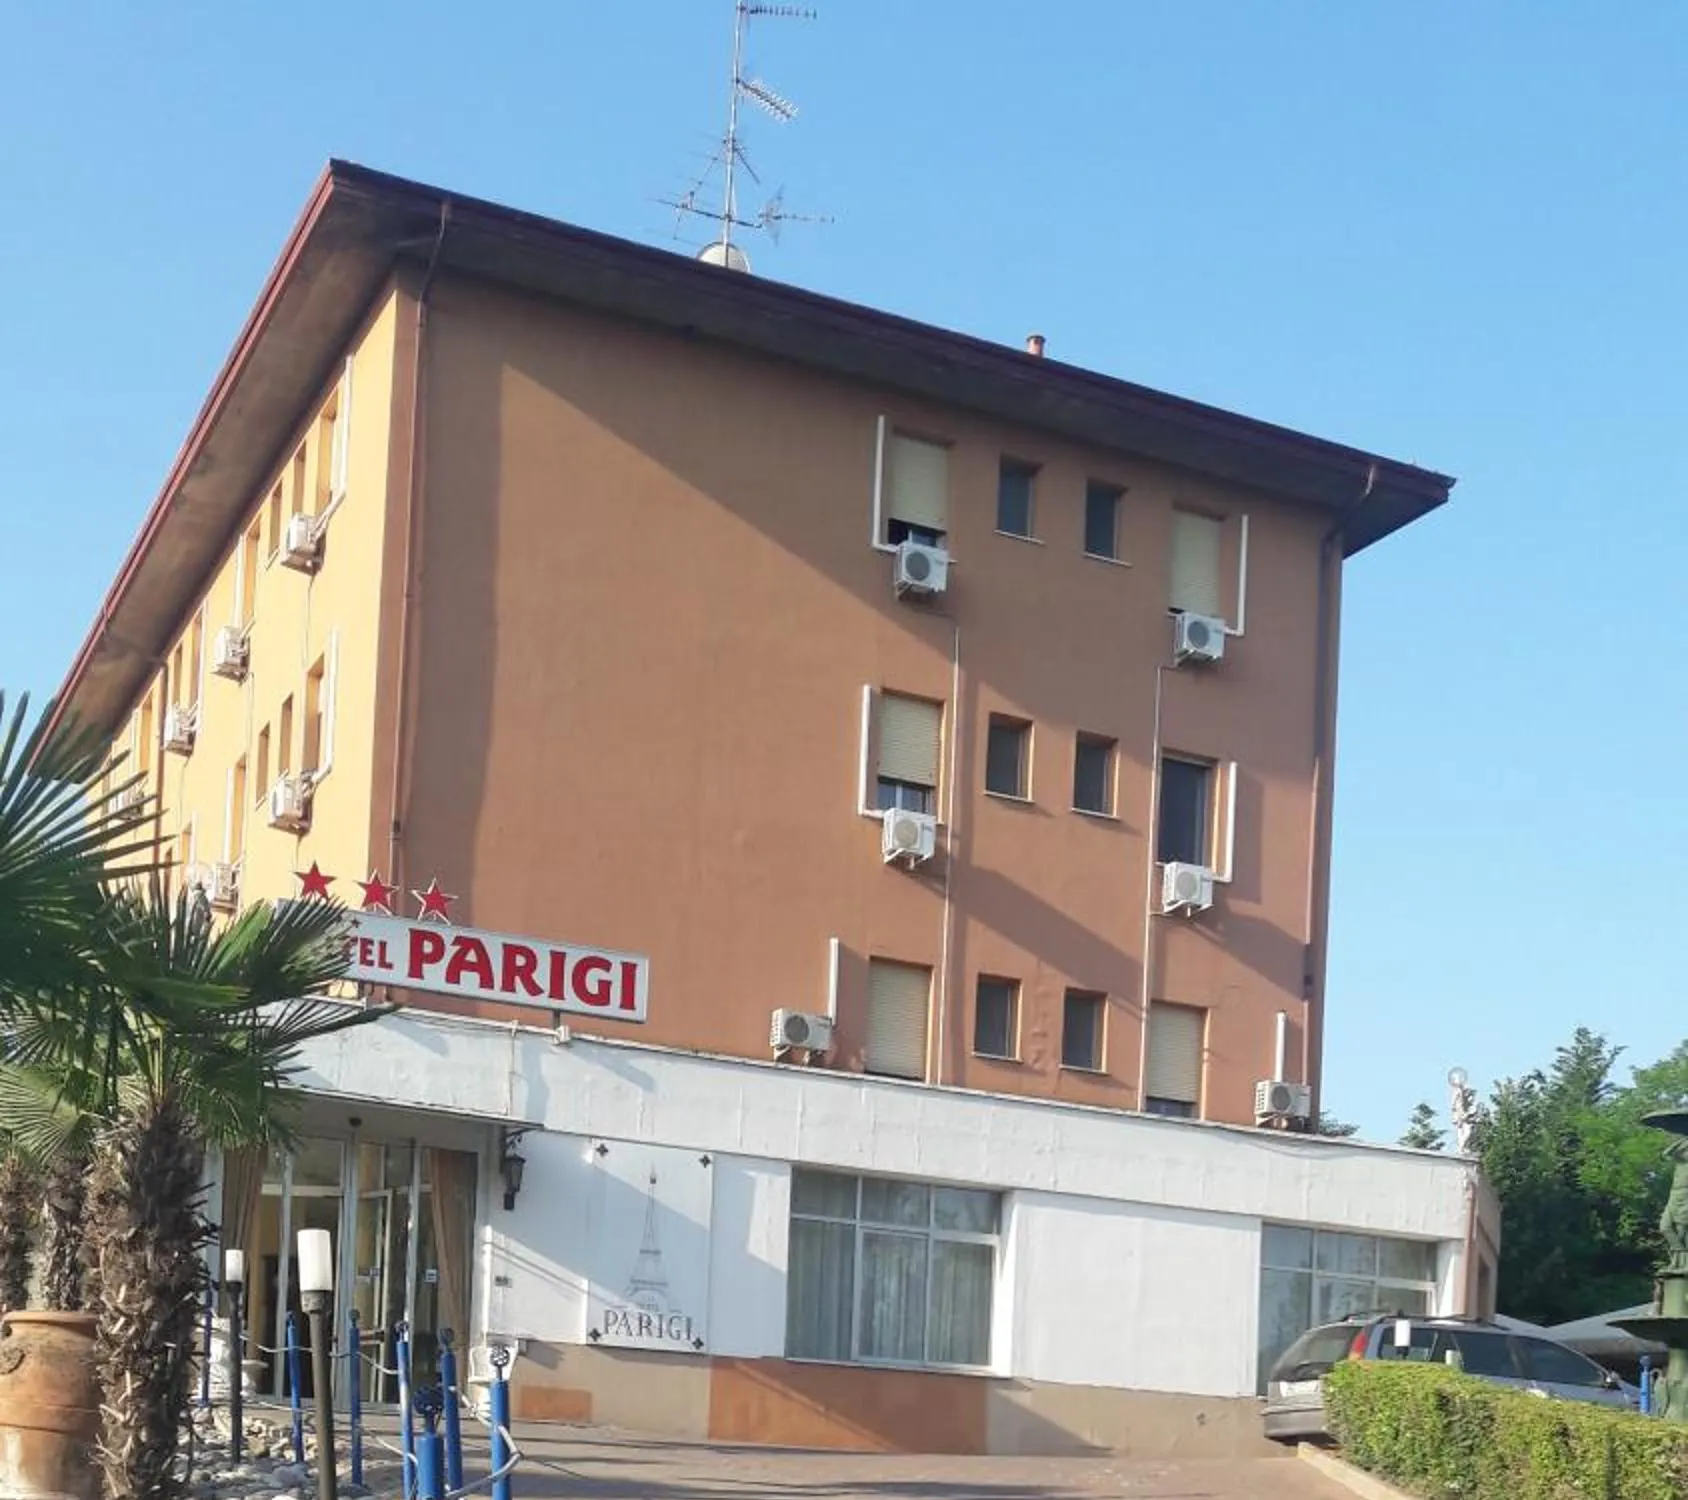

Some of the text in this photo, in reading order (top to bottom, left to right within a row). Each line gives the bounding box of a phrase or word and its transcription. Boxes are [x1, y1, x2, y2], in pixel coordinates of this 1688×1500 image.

[338, 927, 638, 1011] TEL PARIGI
[604, 1309, 693, 1341] PARIGI
